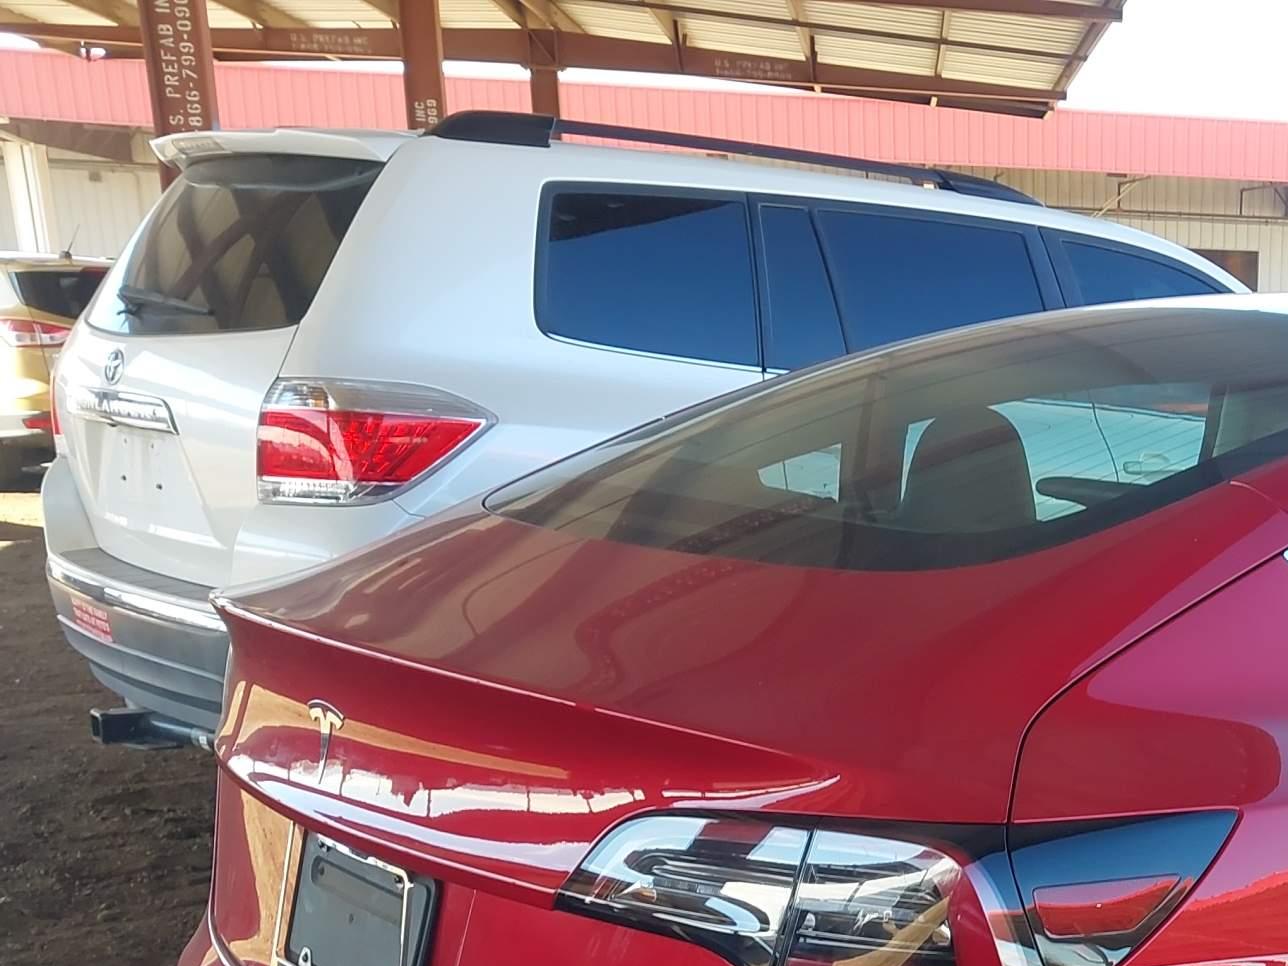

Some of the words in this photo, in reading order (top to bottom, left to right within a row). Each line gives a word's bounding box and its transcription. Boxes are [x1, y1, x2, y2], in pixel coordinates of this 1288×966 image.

[153, 0, 171, 13] IN
[157, 24, 182, 98] PREFAB
[174, 0, 203, 132] 866-799-09
[426, 99, 439, 124] 969
